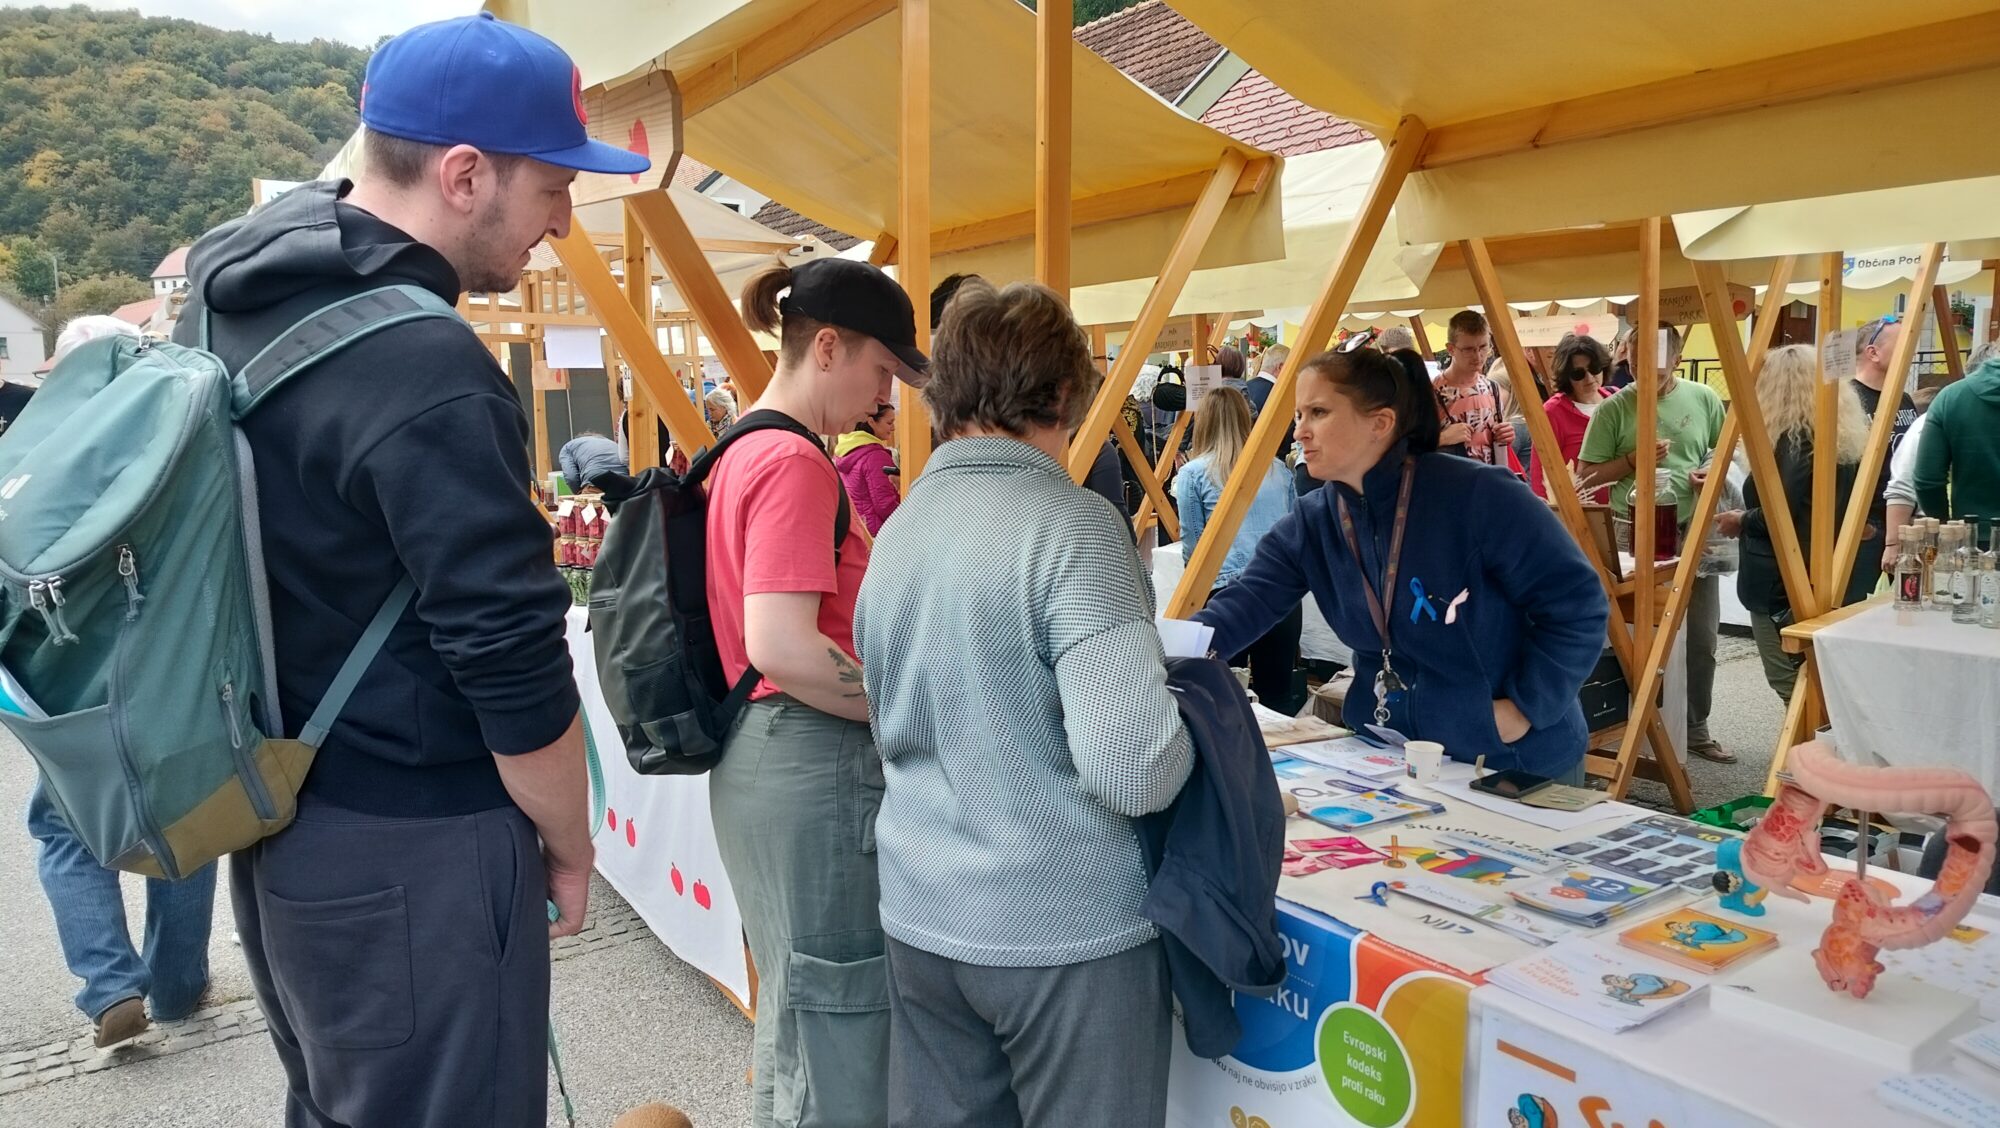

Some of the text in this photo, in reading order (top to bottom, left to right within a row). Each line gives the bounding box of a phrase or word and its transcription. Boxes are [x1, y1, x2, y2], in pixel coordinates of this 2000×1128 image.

[1857, 258, 1896, 269] Občina
[1590, 878, 1626, 894] 12
[1343, 1030, 1387, 1063] Evropski
[1228, 1067, 1241, 1084] naj
[1242, 1074, 1253, 1086] ne
[1254, 1078, 1287, 1096] obvisijo
[1288, 1083, 1294, 1091] v
[1295, 1074, 1317, 1090] zraku
[1347, 1053, 1382, 1082] kodeks
[1342, 1075, 1386, 1107] proti raku
